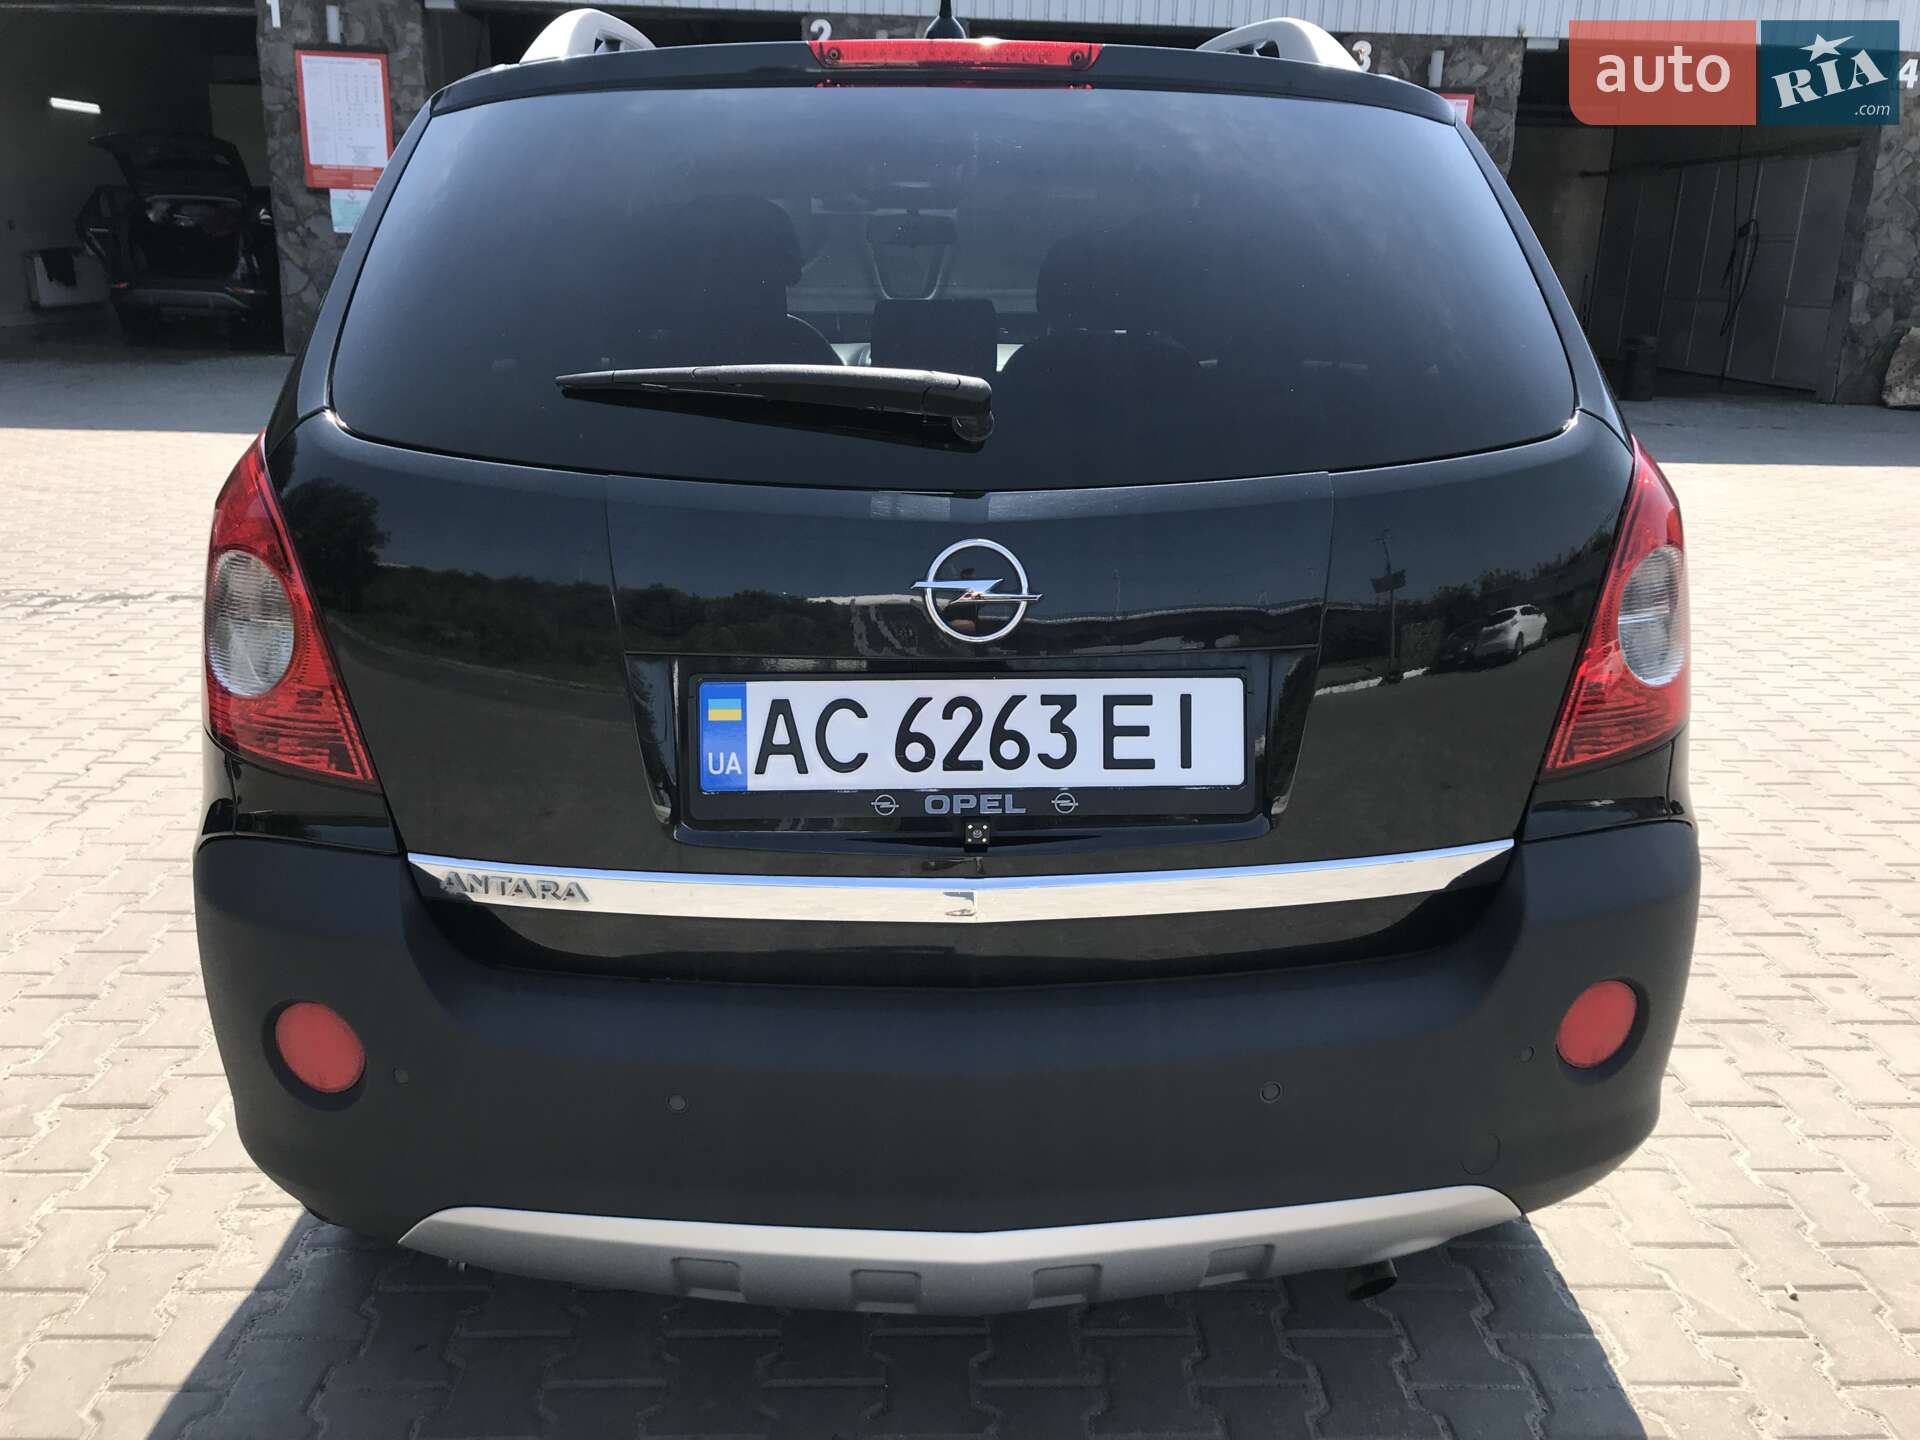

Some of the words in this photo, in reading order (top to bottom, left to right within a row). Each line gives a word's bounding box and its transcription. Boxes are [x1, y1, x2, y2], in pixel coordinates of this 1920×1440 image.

[810, 19, 832, 41] 2
[1352, 40, 1372, 72] 3
[1898, 58, 1918, 89] 4
[754, 698, 869, 775] AC
[894, 694, 1077, 773] 6263
[1103, 693, 1193, 770] EI
[708, 752, 742, 775] UA
[924, 794, 1026, 815] OPEL
[440, 871, 590, 902] ANTARA
